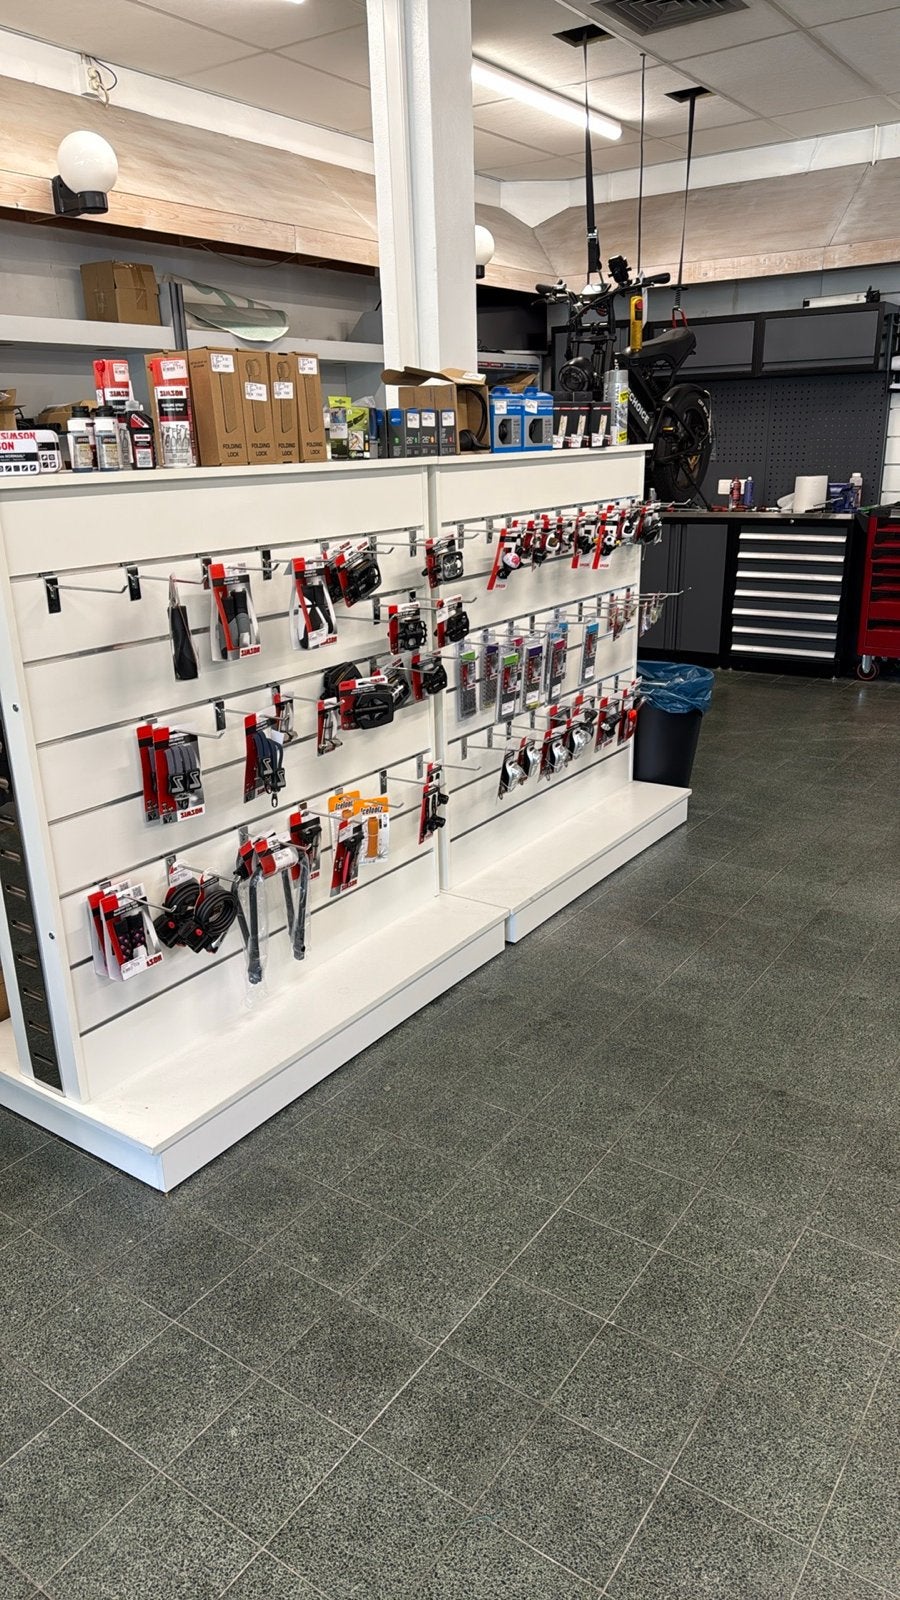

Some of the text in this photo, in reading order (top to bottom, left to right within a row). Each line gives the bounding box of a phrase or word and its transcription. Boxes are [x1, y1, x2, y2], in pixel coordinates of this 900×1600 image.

[1, 432, 36, 440] SIMSON
[0, 441, 15, 451] ON
[241, 646, 260, 657] SIMSON
[180, 807, 203, 818] SIMSON
